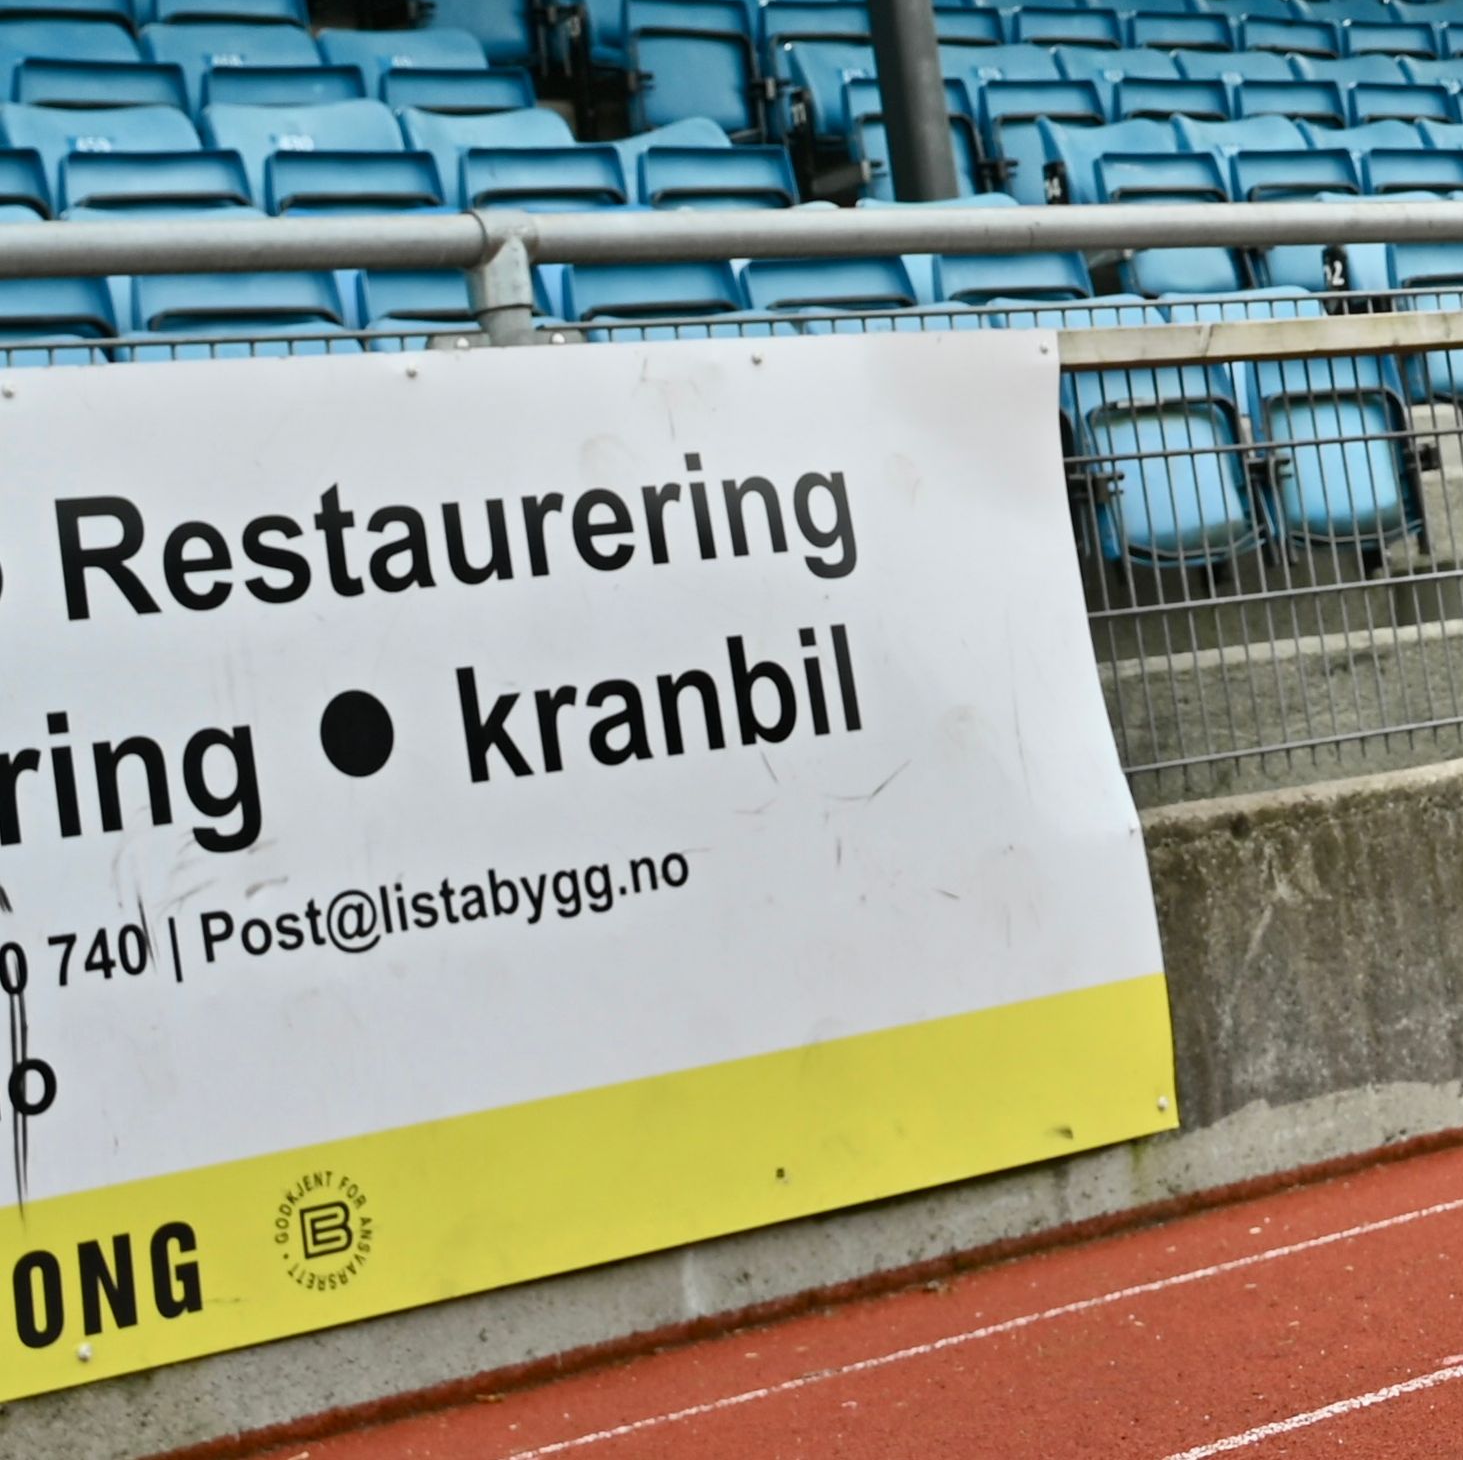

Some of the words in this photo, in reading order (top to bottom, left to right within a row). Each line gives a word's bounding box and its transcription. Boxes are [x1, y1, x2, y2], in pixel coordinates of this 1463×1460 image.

[55, 452, 859, 621] Restaurering
[456, 623, 863, 784] kranbil
[48, 923, 148, 987] 740
[200, 851, 691, 964] Post@listabygg.no
[274, 1170, 333, 1244] GODKJENT
[287, 1216, 373, 1292] ANSVARSRETT
[338, 1176, 368, 1210] FOR
[13, 1221, 203, 1350] ONG
